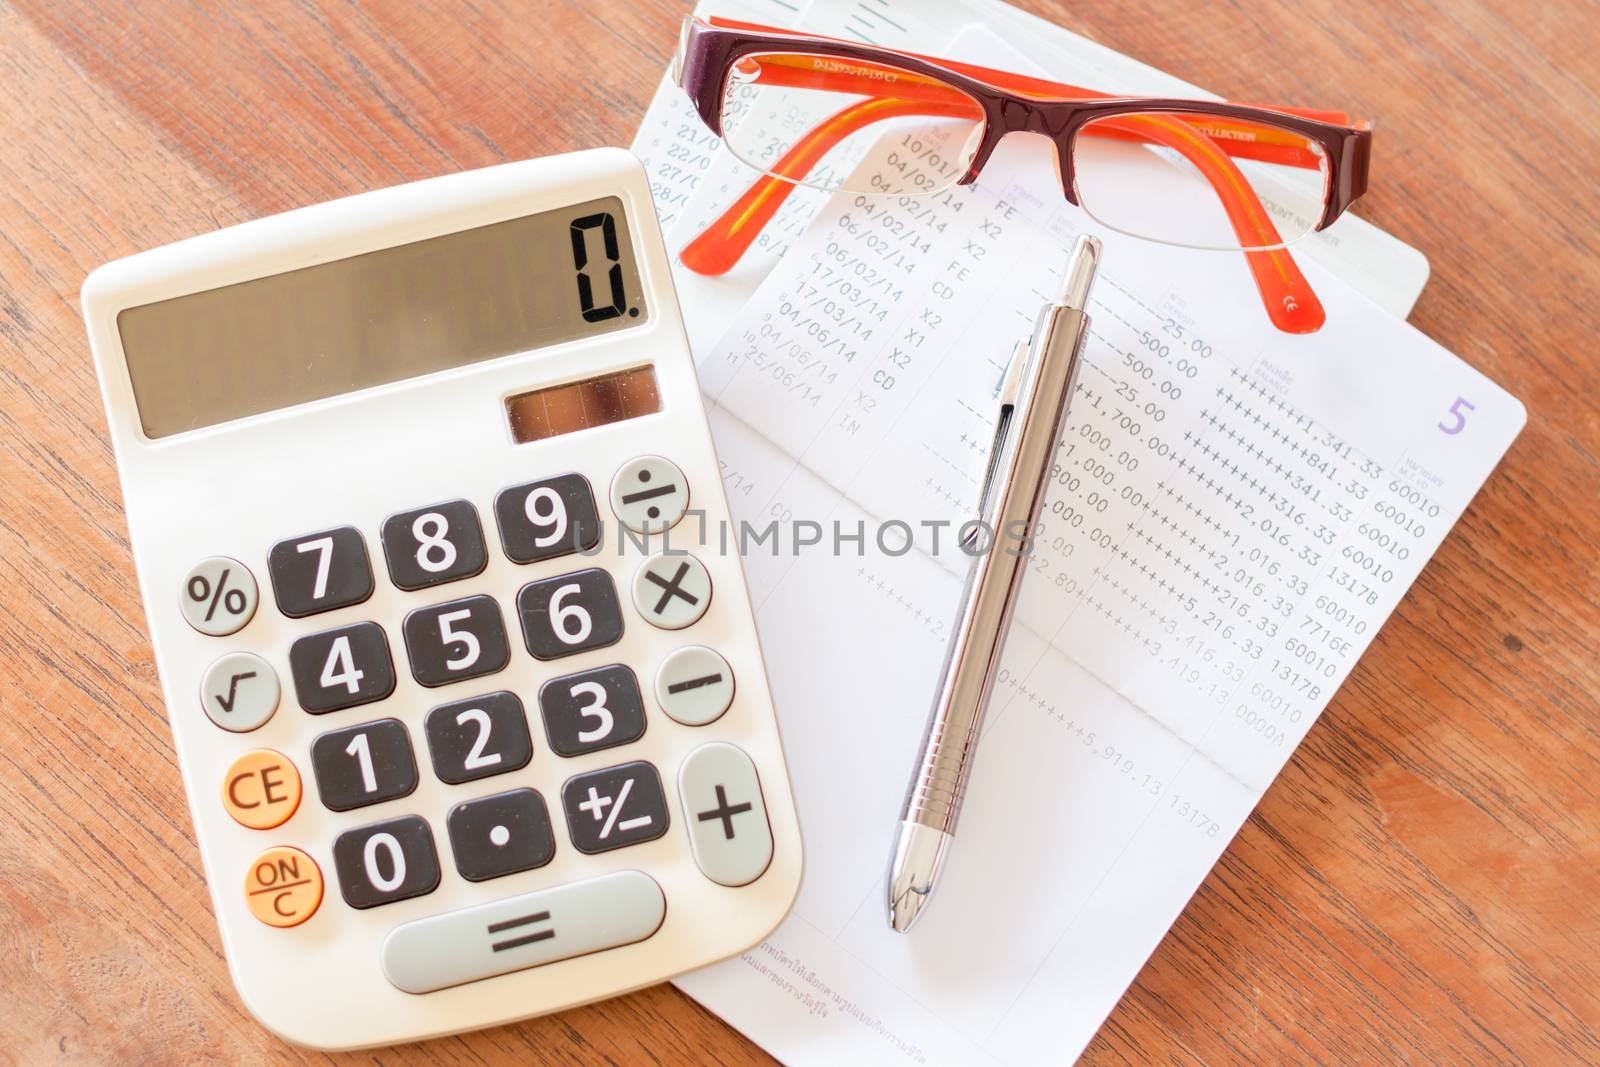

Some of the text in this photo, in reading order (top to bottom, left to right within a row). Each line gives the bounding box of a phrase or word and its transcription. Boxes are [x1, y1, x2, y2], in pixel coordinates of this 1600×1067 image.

[887, 152, 964, 212] 04/02/14
[978, 218, 1002, 240] X2
[1374, 501, 1425, 538] 60010
[903, 135, 977, 191] 10/01/4
[994, 199, 1017, 220] FE
[1388, 480, 1440, 518] 60010
[854, 195, 931, 254] 04/02/14
[946, 260, 970, 281] FE
[1342, 545, 1393, 583] 60010
[870, 172, 947, 232] 04/02/14
[962, 239, 986, 261] X2
[1358, 523, 1409, 560] 60010
[826, 242, 903, 302] 06/02/14
[919, 307, 942, 329] X2
[1315, 595, 1366, 635] 60010
[838, 213, 915, 274] 06/02/14
[931, 280, 954, 300] CD
[1327, 566, 1378, 605] 1317B
[1438, 396, 1476, 435] 5
[796, 281, 872, 341] 17/03/14
[887, 346, 911, 370] X2
[1284, 637, 1336, 678] 60010
[812, 262, 888, 321] 17/03/14
[903, 327, 925, 348] X1
[1299, 615, 1352, 658] 7716E
[524, 487, 568, 547] 9
[760, 323, 838, 384] 04/06/14
[853, 389, 877, 414] X2
[1251, 682, 1302, 723] 60010
[770, 502, 792, 523] CD
[779, 302, 856, 362] 04/06/14
[873, 369, 895, 390] CD
[1271, 659, 1321, 700] 1317B
[296, 537, 334, 599] 7
[412, 512, 457, 572] 8
[744, 345, 821, 407] 25/06/14
[839, 413, 862, 435] IN
[1235, 703, 1285, 747] 0000A
[188, 569, 246, 622] %
[548, 583, 593, 645] 6
[320, 636, 363, 694] 4
[438, 610, 481, 670] 5
[456, 709, 501, 770] 2
[569, 682, 614, 743] 3
[229, 765, 288, 810] CE
[345, 733, 378, 793] 1
[255, 857, 300, 887] ON
[363, 832, 406, 892] 0
[273, 892, 296, 918] C
